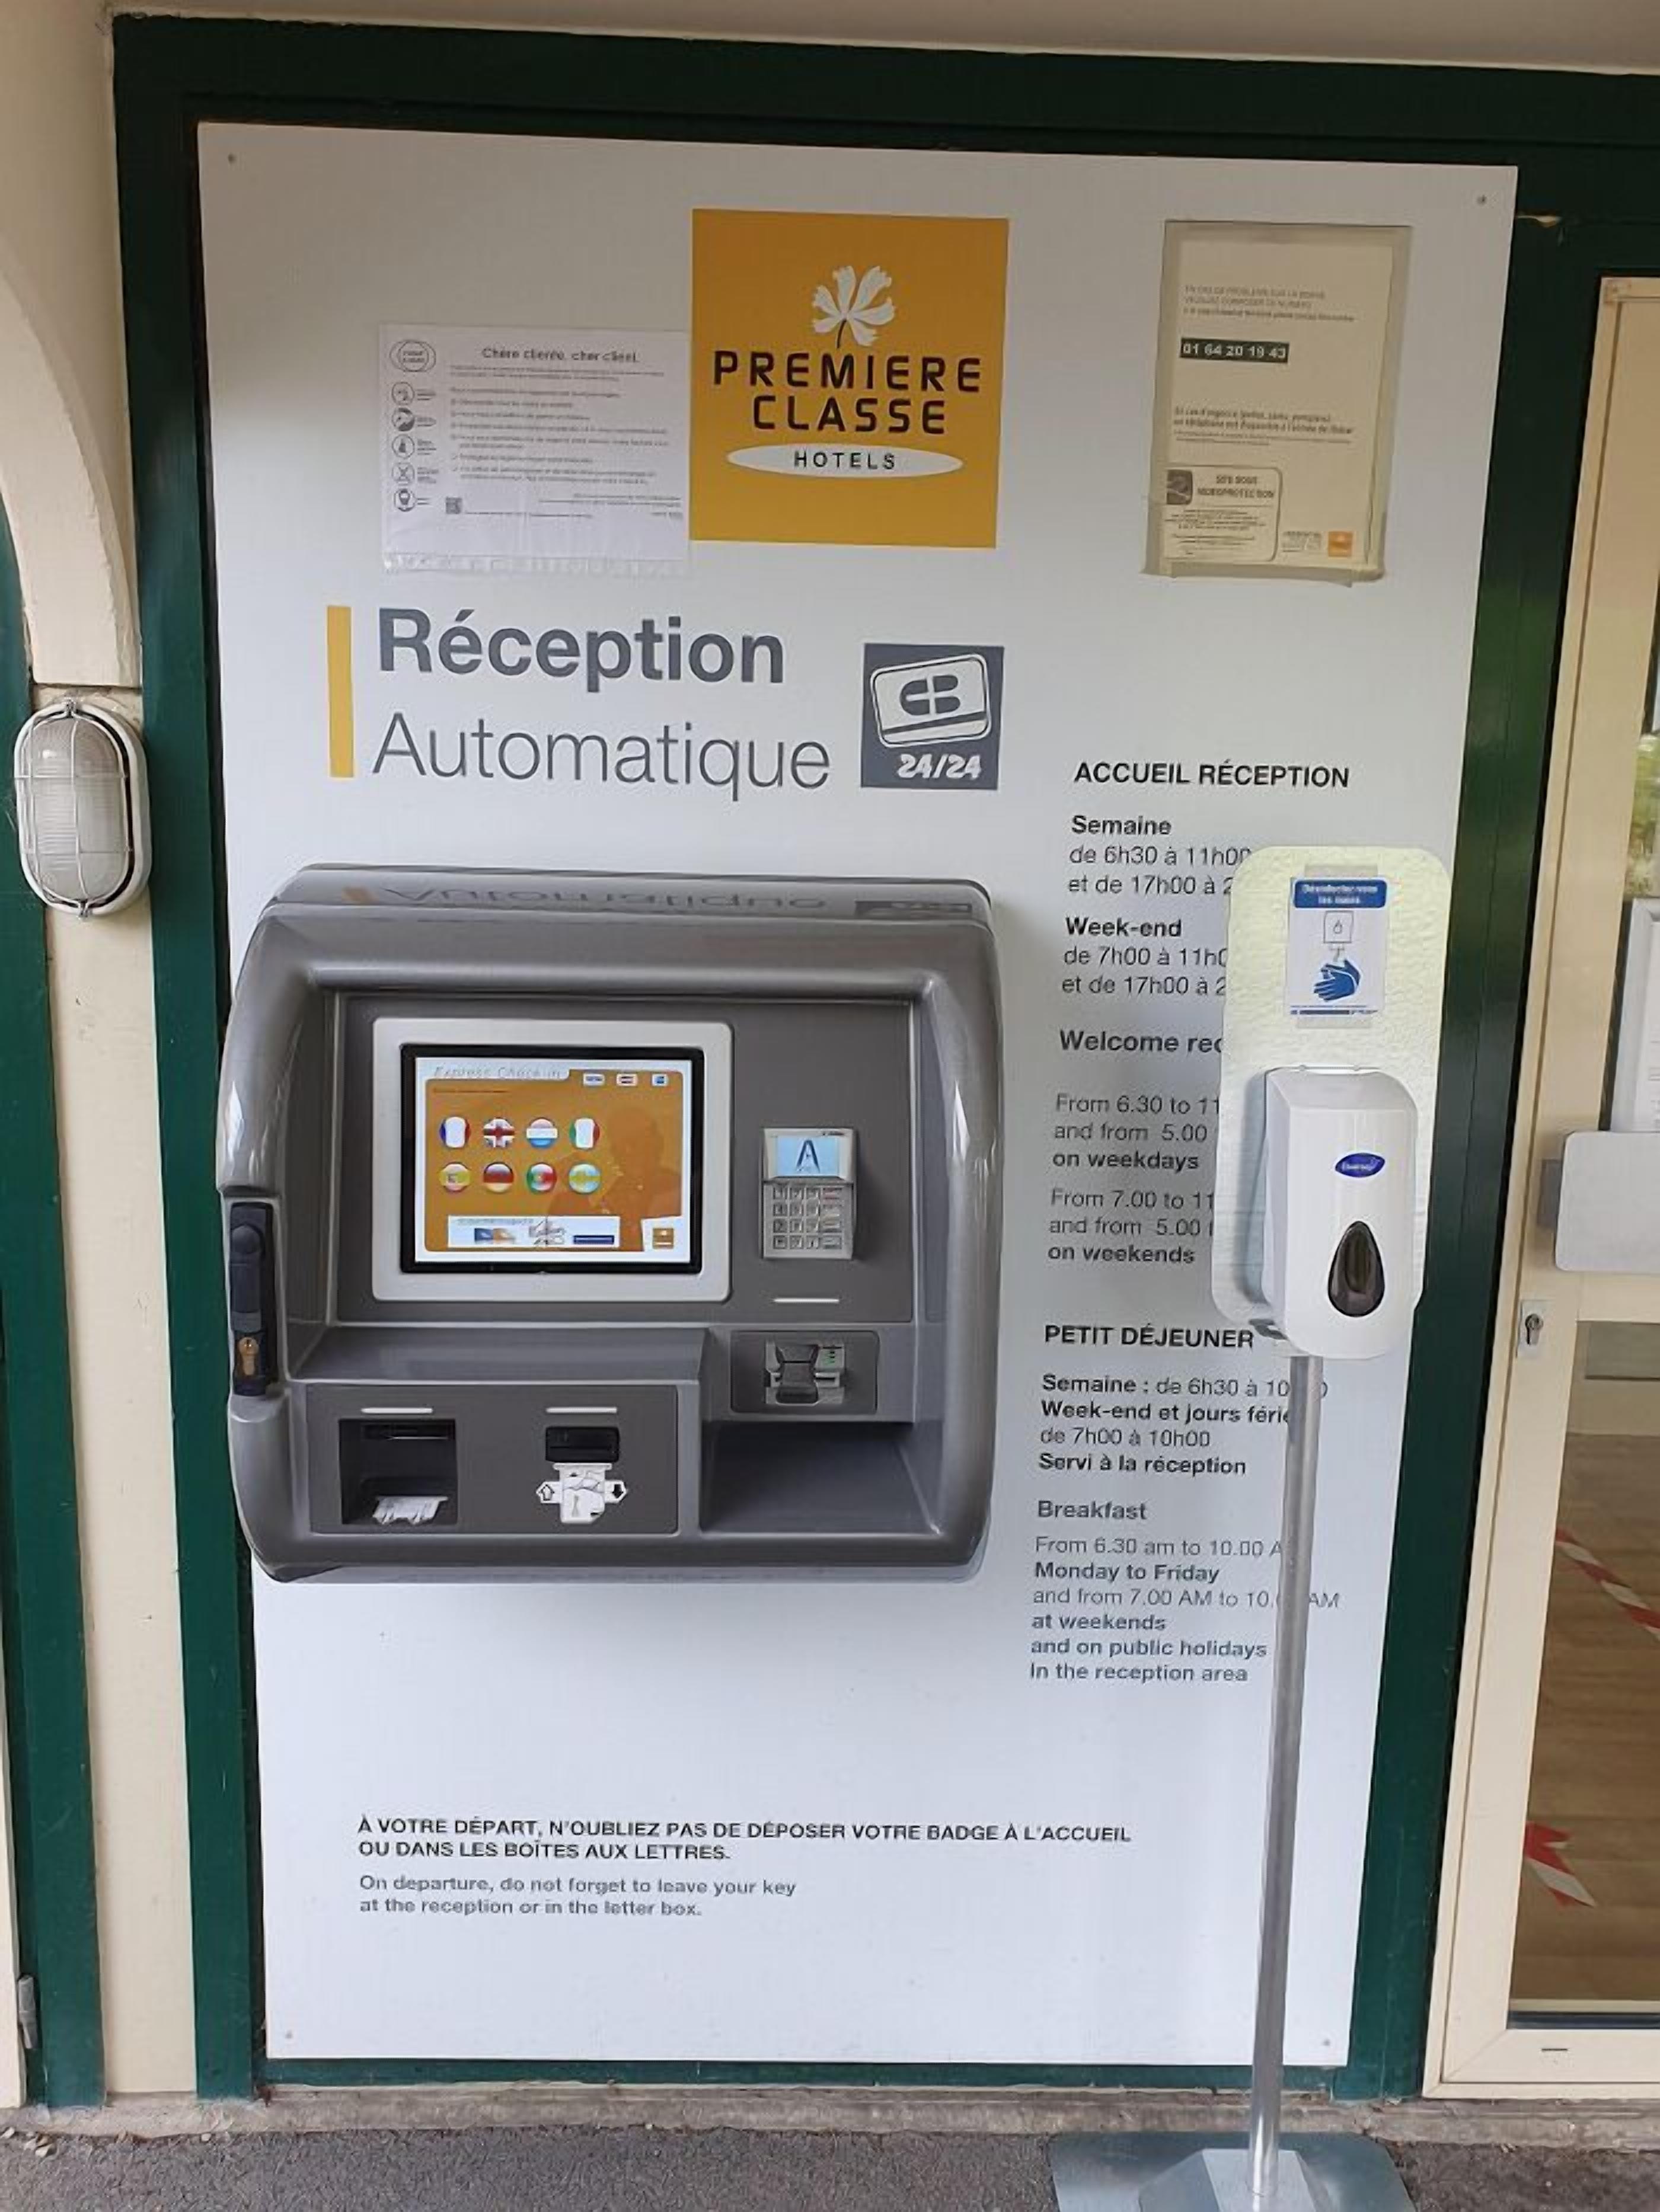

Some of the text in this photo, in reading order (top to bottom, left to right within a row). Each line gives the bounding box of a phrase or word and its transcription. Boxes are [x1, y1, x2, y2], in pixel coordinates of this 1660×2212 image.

[1182, 343, 1199, 356] 01
[1204, 344, 1222, 356] 64
[1226, 345, 1243, 357] 20
[713, 350, 981, 393] PREMIERE
[753, 395, 945, 434] CLASSE
[793, 450, 895, 471] HOTELS
[378, 608, 784, 693] Réception
[372, 711, 831, 802] Automatique
[897, 753, 982, 779] 24/24
[1074, 759, 1350, 788] ACCUEIL RÉCEPTION
[1071, 815, 1172, 835] Semaine
[1069, 845, 1096, 864] de
[1104, 846, 1158, 865] 6h30
[1164, 846, 1177, 865] à
[1068, 875, 1088, 893] et
[1095, 875, 1122, 893] de
[1131, 875, 1196, 894] 17h00
[1204, 875, 1215, 894] à
[1065, 916, 1182, 937] Week-end
[1063, 947, 1227, 967] de 7h00 à 11h0
[1062, 976, 1081, 994] et
[1088, 976, 1115, 994] de
[1124, 976, 1189, 995] 17h00
[1196, 977, 1208, 995] à
[1059, 1030, 1179, 1052] Welcome
[1056, 1093, 1110, 1113] From
[1116, 1095, 1163, 1114] 6.30
[1170, 1097, 1190, 1114] to
[1054, 1121, 1208, 1143] and from 5.00
[1052, 1151, 1200, 1174] on weekdays
[1051, 1188, 1104, 1207] From
[1111, 1190, 1157, 1209] 7.00
[1163, 1193, 1185, 1210] to
[1048, 1217, 1087, 1234] and
[1096, 1216, 1142, 1236] from
[1155, 1219, 1201, 1236] 5.00
[1048, 1245, 1196, 1264] on weekends
[1045, 1323, 1254, 1350] PETIT DÉJEUNER
[1042, 1374, 1137, 1395] Semaine
[1156, 1376, 1182, 1395] de
[1188, 1377, 1238, 1396] 6h30
[1247, 1379, 1257, 1397] à
[1041, 1400, 1151, 1421] Week-end
[1158, 1405, 1179, 1421] et
[1184, 1404, 1241, 1425] jours
[1040, 1428, 1211, 1447] de 7h00 à 10h00
[1039, 1453, 1246, 1477] Servi à la réception
[1037, 1500, 1148, 1520] Breakfast
[1035, 1536, 1283, 1557] From 6.30 am to 10.00 A
[1035, 1562, 1220, 1584] Monday to Friday
[1033, 1588, 1071, 1604] and
[1077, 1588, 1123, 1605] from
[1131, 1590, 1173, 1606] 7.00
[1178, 1591, 1213, 1607] AM
[1220, 1590, 1238, 1607] to
[1032, 1615, 1167, 1631] at weekends
[1031, 1638, 1268, 1660] and on public holidays
[1056, 1663, 1089, 1679] the
[1094, 1664, 1195, 1684] reception
[1202, 1668, 1249, 1682] area
[357, 1815, 1131, 1842] À VOTRE DÉPART, N'OUBLIEZ PAS DE DÉPOSER VOTRE BADGE À L'ACCUEIL
[359, 1839, 731, 1860] OU DANS LES BOÎTES AUX LETTRES.
[360, 1875, 796, 1897] On departure, do not forget to leave your key
[360, 1898, 702, 1916] at the reception or in the letter box.
